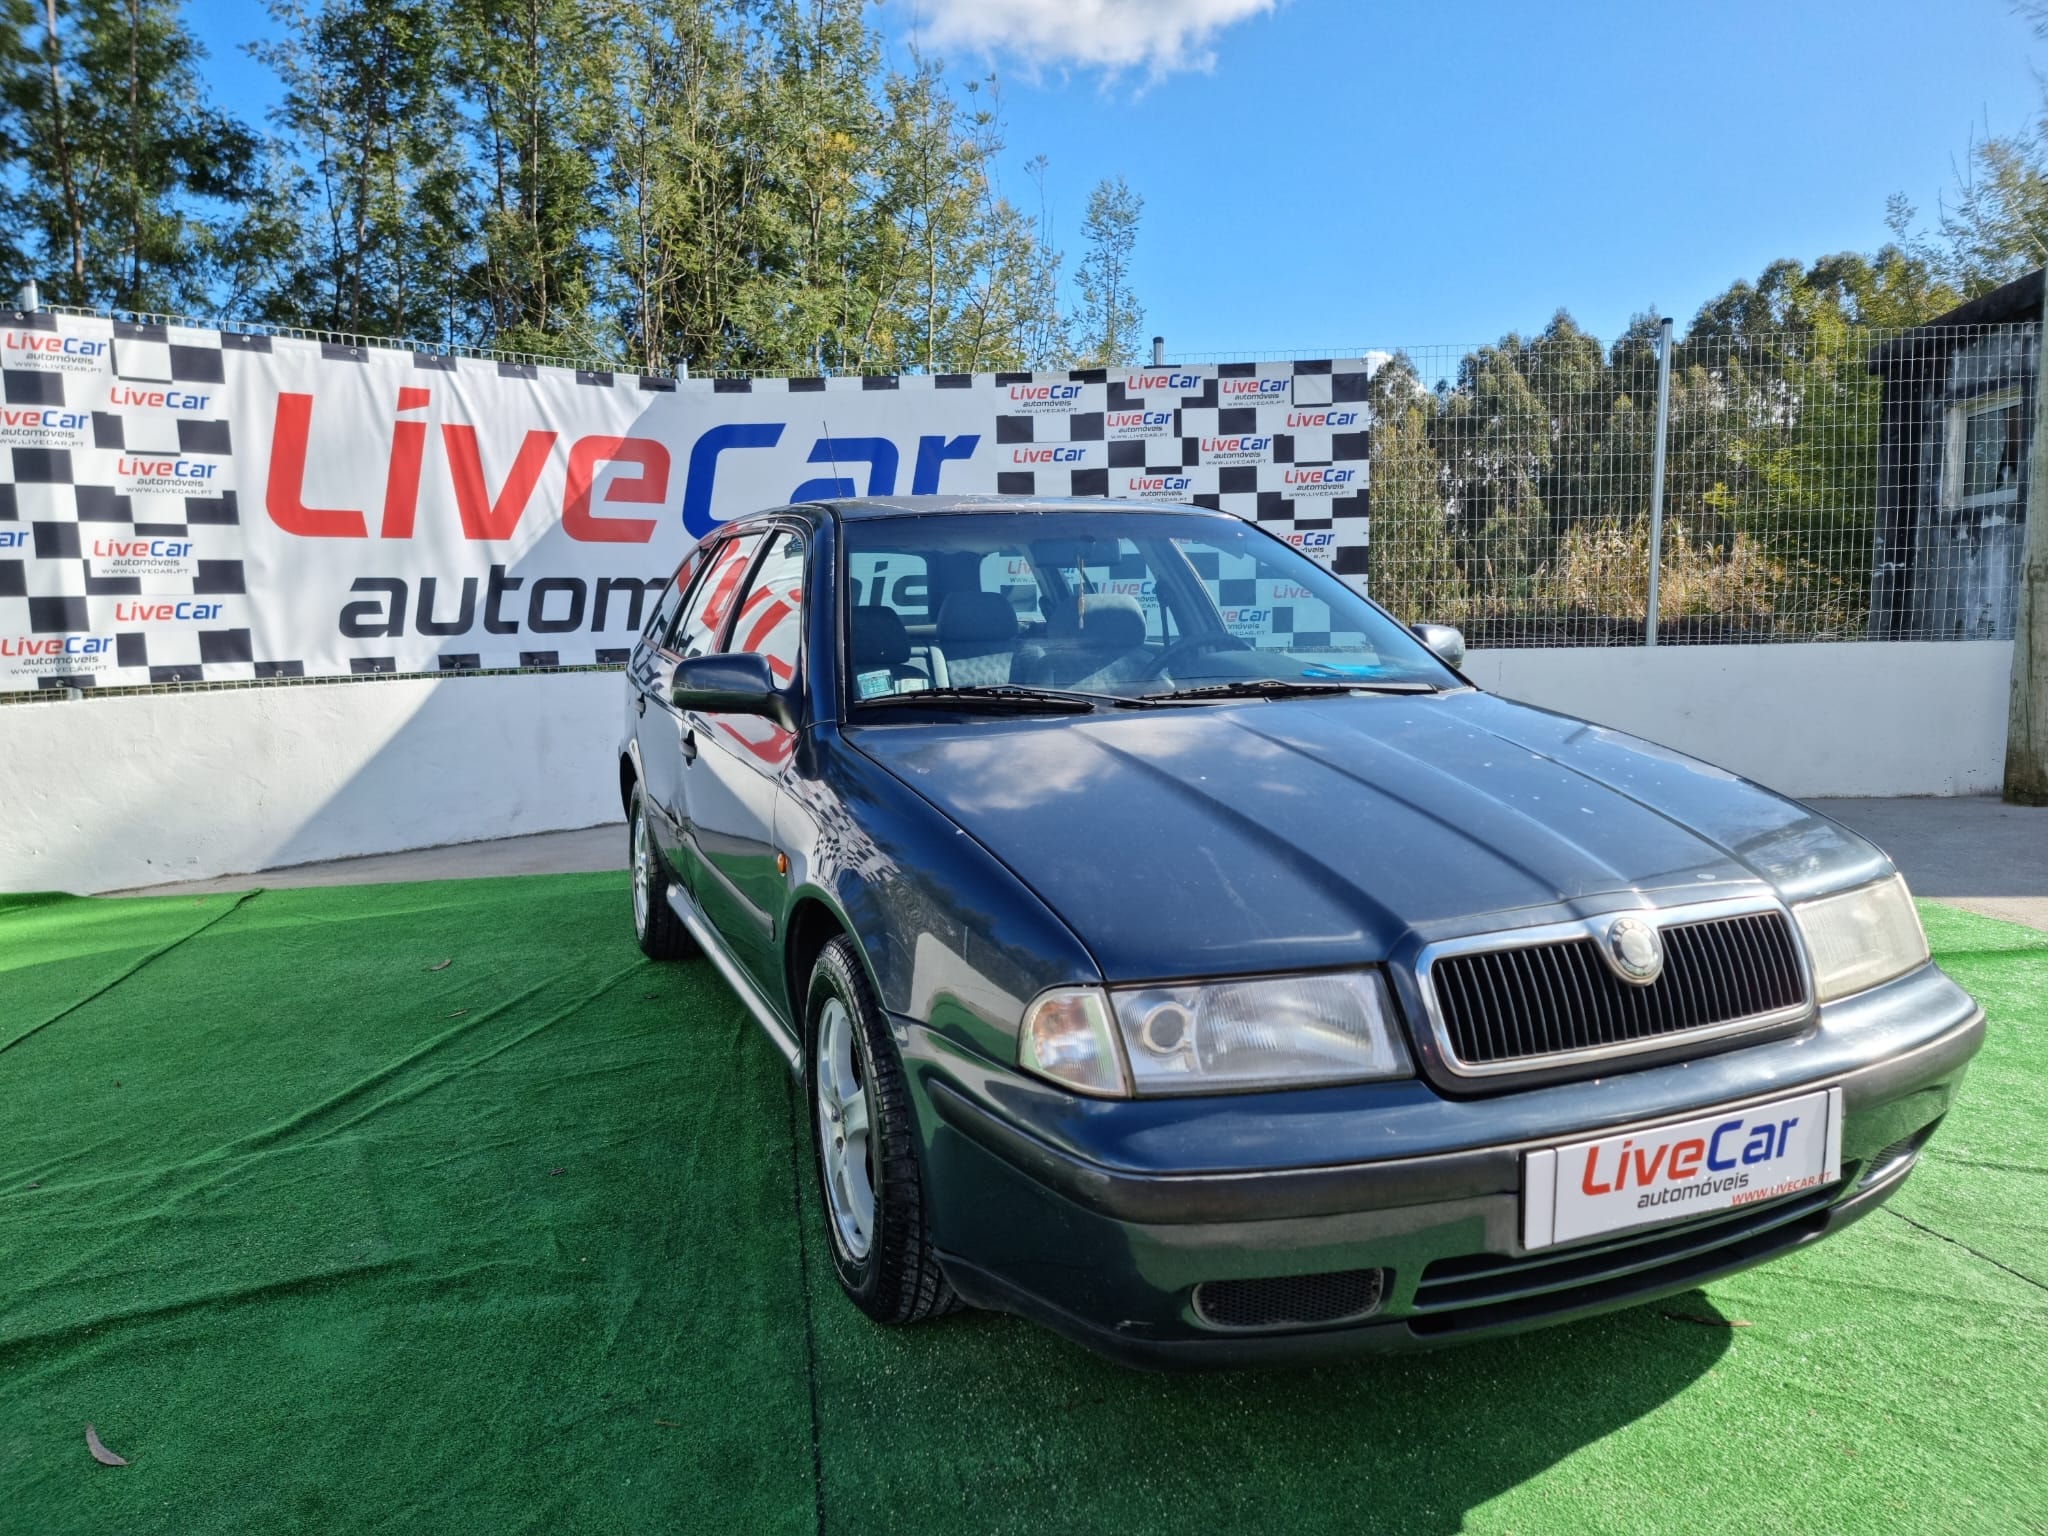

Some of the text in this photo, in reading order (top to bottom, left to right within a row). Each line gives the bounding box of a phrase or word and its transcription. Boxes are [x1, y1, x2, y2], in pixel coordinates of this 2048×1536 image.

[6, 331, 107, 356] LiveCar
[26, 351, 95, 365] automóveis
[1128, 374, 1201, 390] LiveCar
[1223, 379, 1290, 394] LiveCar
[110, 387, 210, 410] LiveCar
[1010, 385, 1083, 401] LiveCar
[1235, 393, 1280, 401] automóveis
[1023, 400, 1072, 408] automóveis
[0, 406, 89, 429] veCar
[1107, 412, 1172, 427] LiveCar
[1287, 412, 1358, 427] LiveCar
[1, 427, 75, 439] automóveis
[1118, 425, 1163, 433] automóveis
[1201, 437, 1271, 452] LiveCar
[1013, 448, 1086, 463] LiveCar
[1214, 451, 1261, 459] automóveis
[118, 457, 218, 479] LiveCar
[265, 386, 982, 544] LiveCar
[137, 478, 204, 488] automóveis
[1129, 477, 1191, 491] LiveCar
[1284, 469, 1355, 484] LiveCar
[1297, 483, 1344, 491] automóveis
[93, 539, 193, 557] LiveCar
[113, 558, 180, 567] automóveis
[1273, 584, 1312, 598] Live
[116, 602, 223, 622] LiveCar
[1, 636, 113, 657] LiveCar
[23, 655, 99, 665] automóveis
[1581, 1116, 1800, 1197] LiveCar
[1637, 1172, 1750, 1209] automóveis
[1731, 1170, 1831, 1207] WWW.LIVECAR.PT
